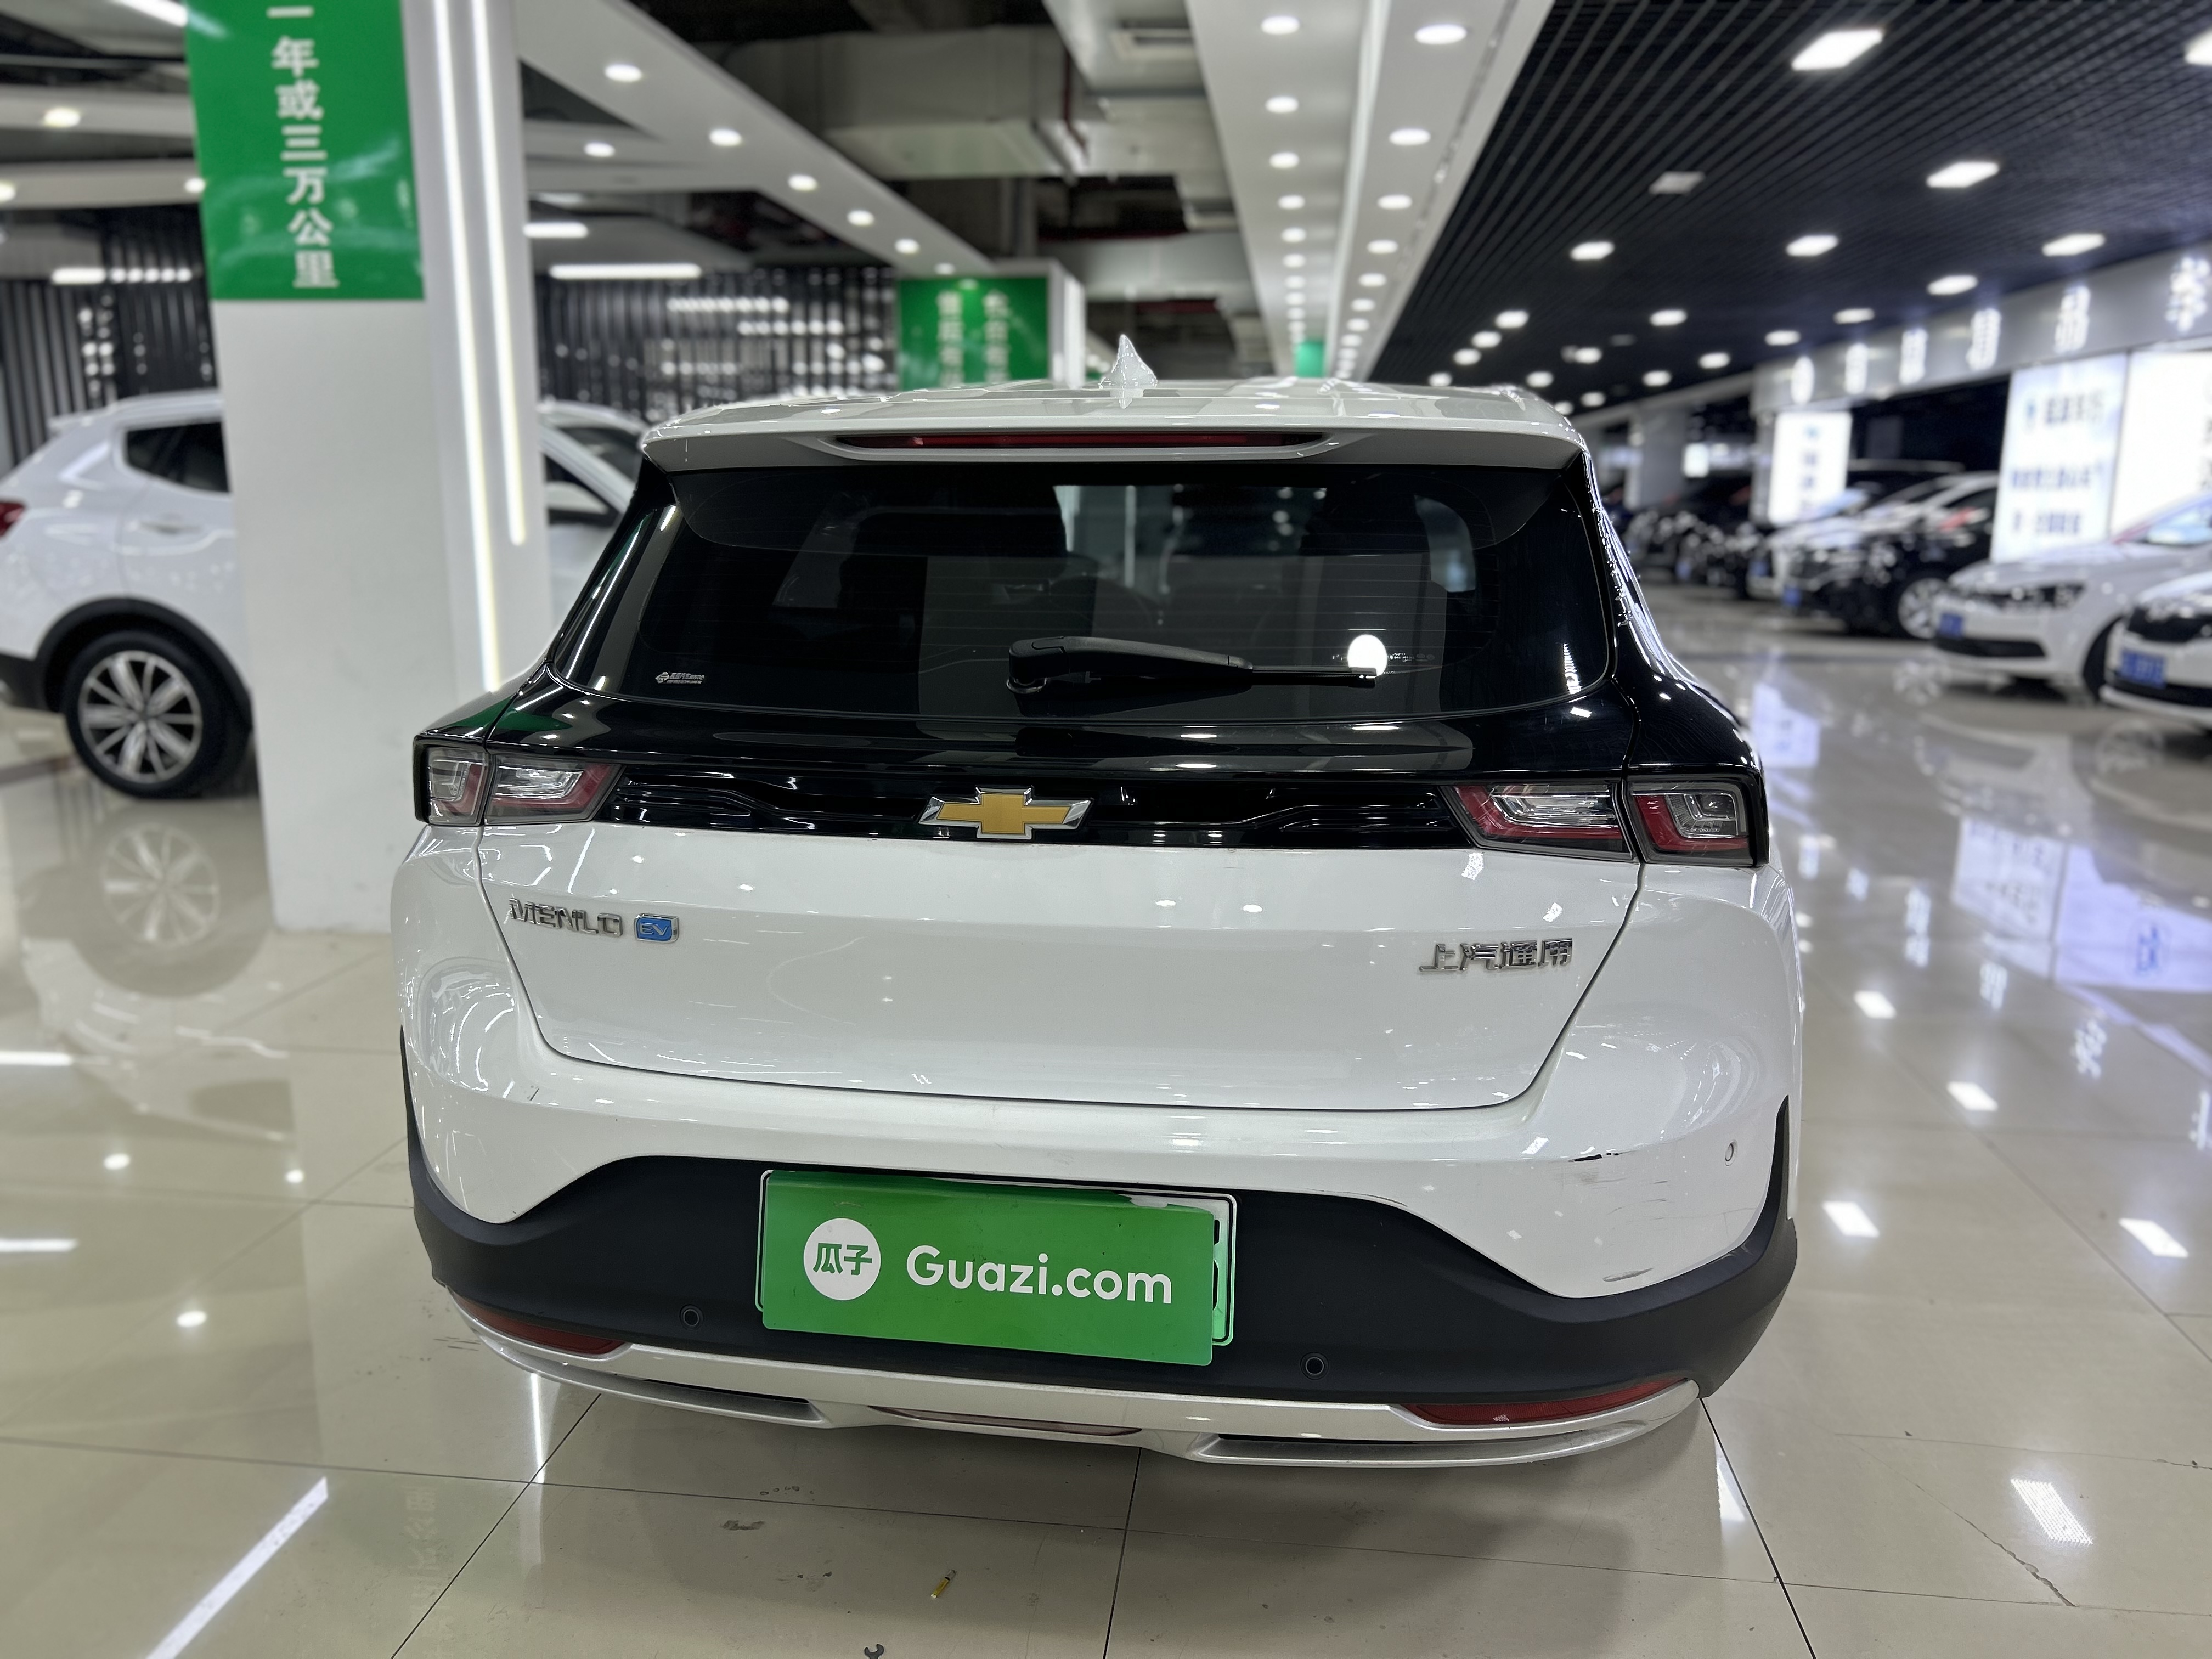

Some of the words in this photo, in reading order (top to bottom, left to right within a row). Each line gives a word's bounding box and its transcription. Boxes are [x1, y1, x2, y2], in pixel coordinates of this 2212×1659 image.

[267, 4, 340, 289] 一年或三万公里
[509, 898, 623, 936] MENLO
[639, 922, 669, 936] EV
[1419, 938, 1573, 970] 上汽通用
[812, 1242, 872, 1276] 瓜子
[906, 1244, 1172, 1304] Guazi.com
